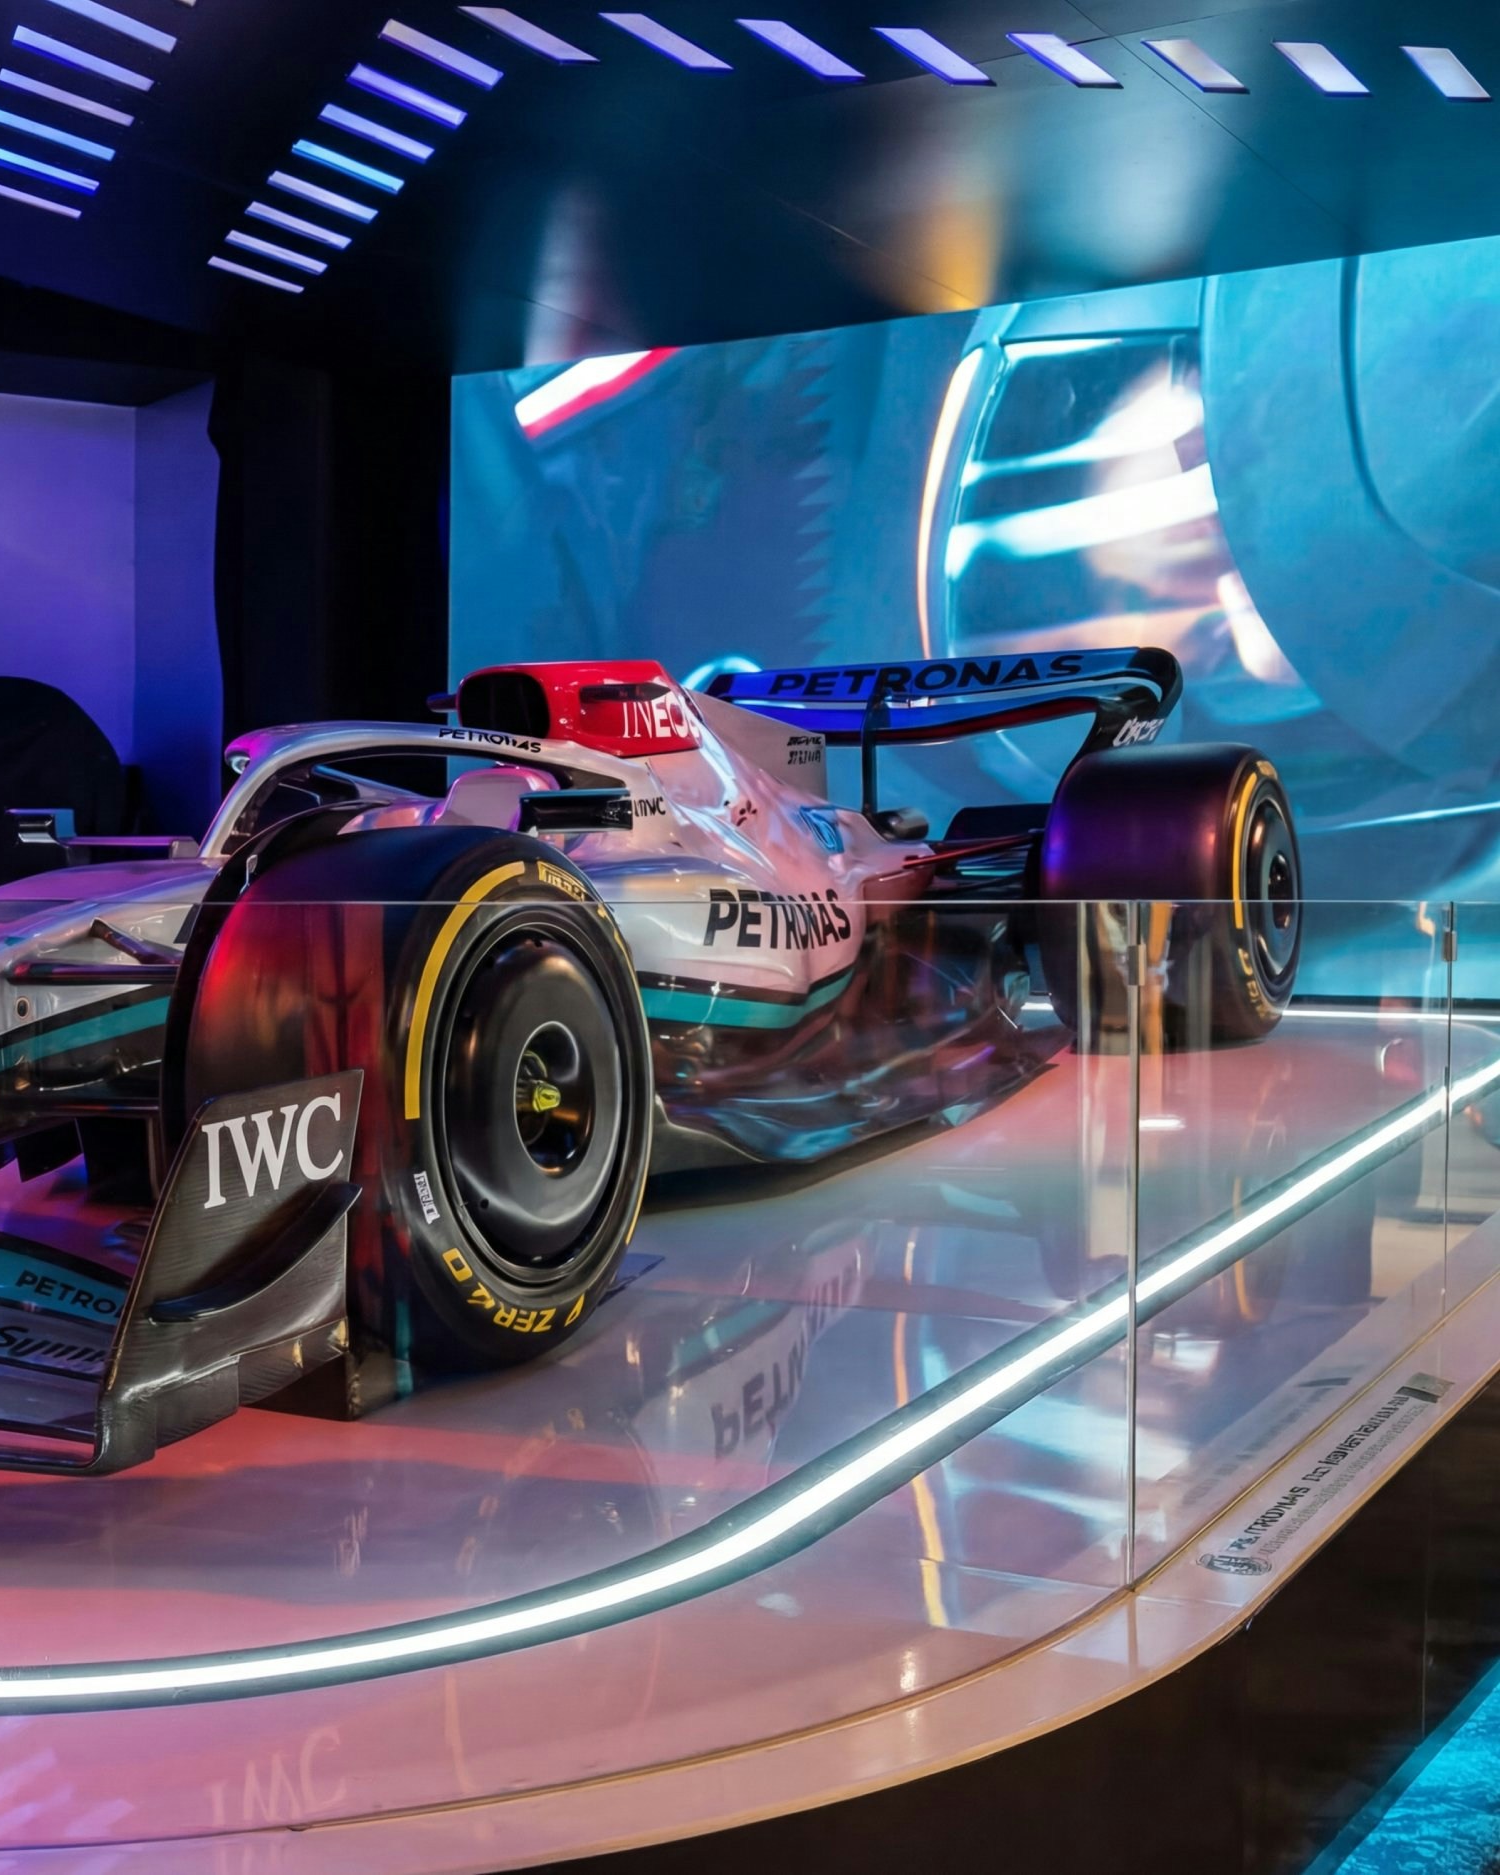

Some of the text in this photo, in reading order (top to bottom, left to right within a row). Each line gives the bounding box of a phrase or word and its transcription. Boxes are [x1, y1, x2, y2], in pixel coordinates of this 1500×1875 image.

[769, 655, 1084, 696] PETRONAS
[438, 728, 542, 753] PETRONAS
[703, 888, 851, 950] PETRONAS
[201, 1091, 344, 1210] IWC
